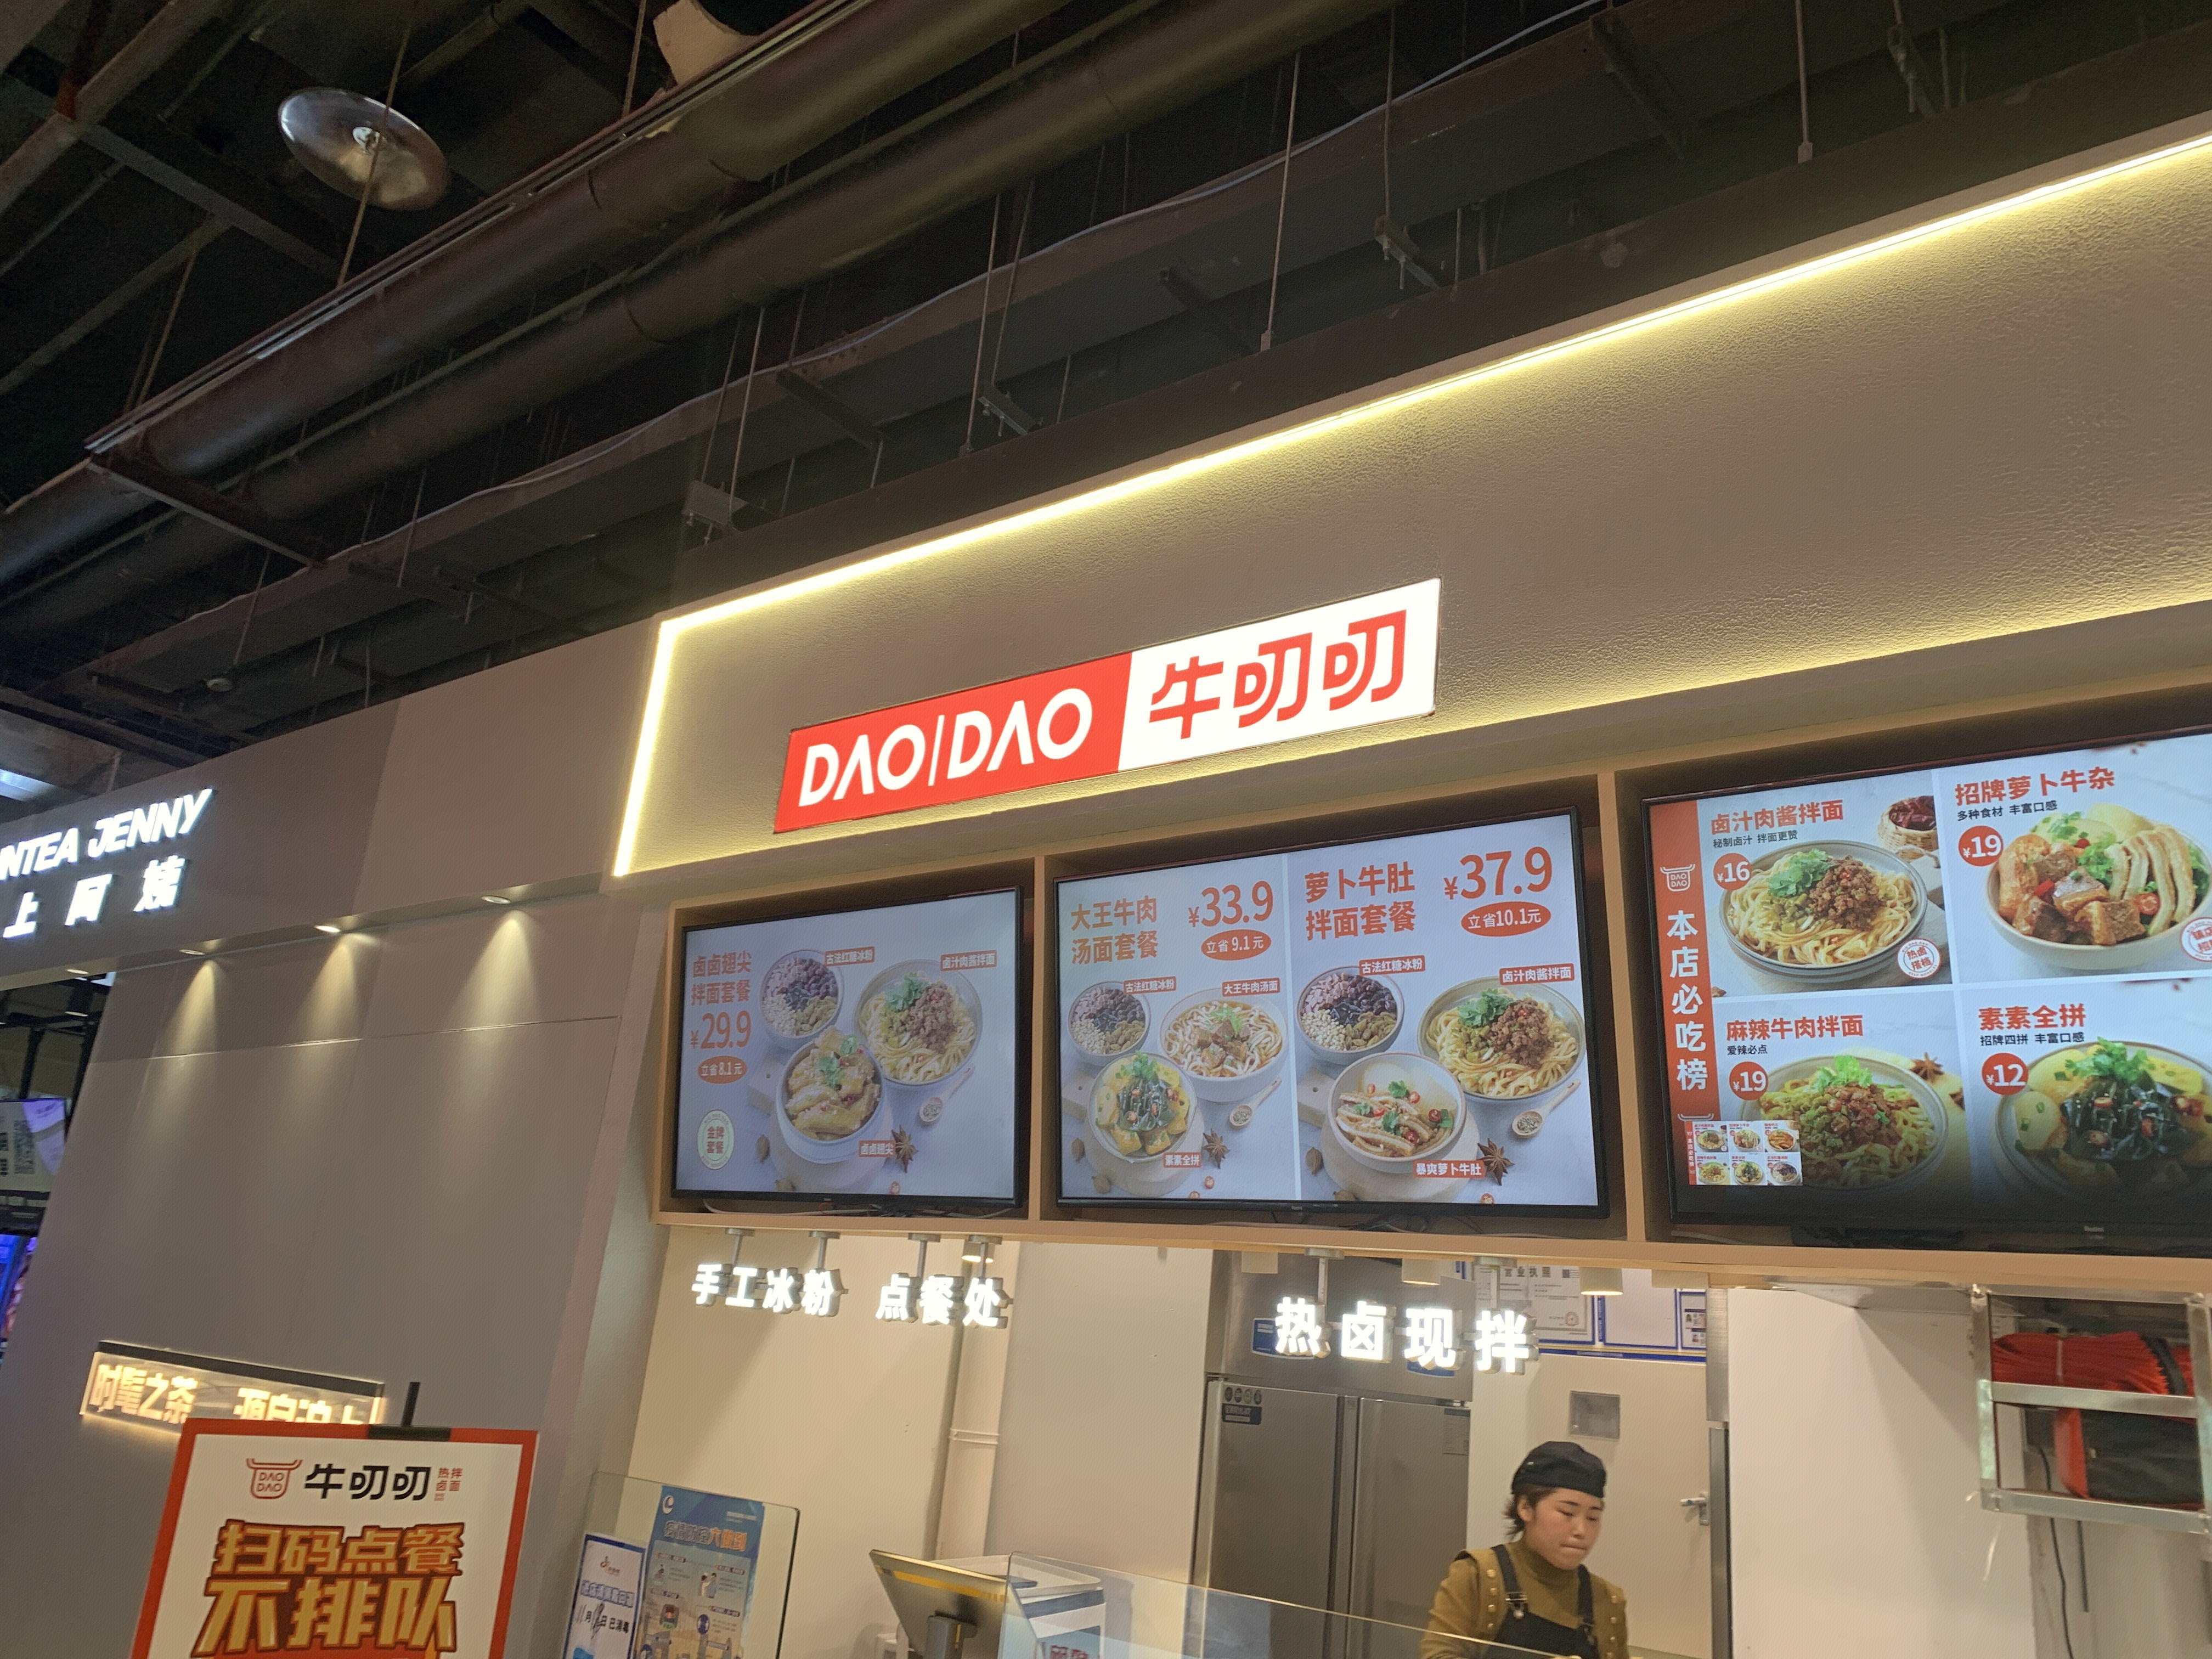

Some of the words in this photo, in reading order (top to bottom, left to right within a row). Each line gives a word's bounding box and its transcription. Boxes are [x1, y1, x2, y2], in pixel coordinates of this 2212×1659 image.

[1149, 609, 1407, 740] 牛叨叨
[1955, 766, 2115, 806] 招牌萝卜牛杂
[88, 788, 213, 857] JENNY
[1711, 800, 1844, 835] 卤汁肉酱拌面
[1957, 806, 2003, 821] 多种食材
[2009, 800, 2058, 815] 丰富口感
[1713, 836, 1752, 848] 秘制卤汁
[1757, 830, 1798, 844] 拌面更赞
[1963, 834, 2001, 858] ¥19
[1305, 861, 1415, 904] 萝卜牛肚
[1443, 847, 1553, 900] ¥37.9
[1717, 860, 1751, 882] ¥16
[1070, 895, 1158, 931] 大王牛肉
[1188, 881, 1273, 928] ¥33.9
[1306, 900, 1417, 941] 拌面套餐
[1071, 930, 1159, 965] 汤面套餐
[692, 950, 752, 978] 卤卤翅尖
[1361, 958, 1423, 975] 古法红糖冰粉
[1502, 966, 1572, 983] 卤汁肉酱拌面
[691, 979, 751, 1006] 拌面套餐
[1125, 979, 1175, 993] 古法红糖冰粉
[1224, 980, 1278, 995] 大王牛肉汤面
[1667, 910, 1708, 1091] 本店必吃榜
[691, 1010, 752, 1049] ¥29.9
[1726, 1014, 1864, 1041] 麻辣牛肉拌面
[1978, 1003, 2086, 1031] 素素全拼
[1727, 1044, 1768, 1056] 爱辣必点
[1980, 1034, 2029, 1046] 招牌四拼
[2034, 1031, 2085, 1044] 丰富口感
[1733, 1070, 1767, 1091] ¥19
[1986, 1064, 2026, 1087] ¥12
[1165, 1154, 1200, 1166] 素素全拼
[692, 1263, 834, 1316] 手工冰粉
[876, 1273, 1001, 1327] 点餐处
[1276, 1296, 1530, 1373] 热卤现拌
[257, 1483, 284, 1492] DAO
[259, 1472, 285, 1481] DAO
[304, 1463, 432, 1501] 牛叨叨
[211, 1519, 465, 1577] 扫码点餐
[190, 1576, 456, 1658] 不排队
